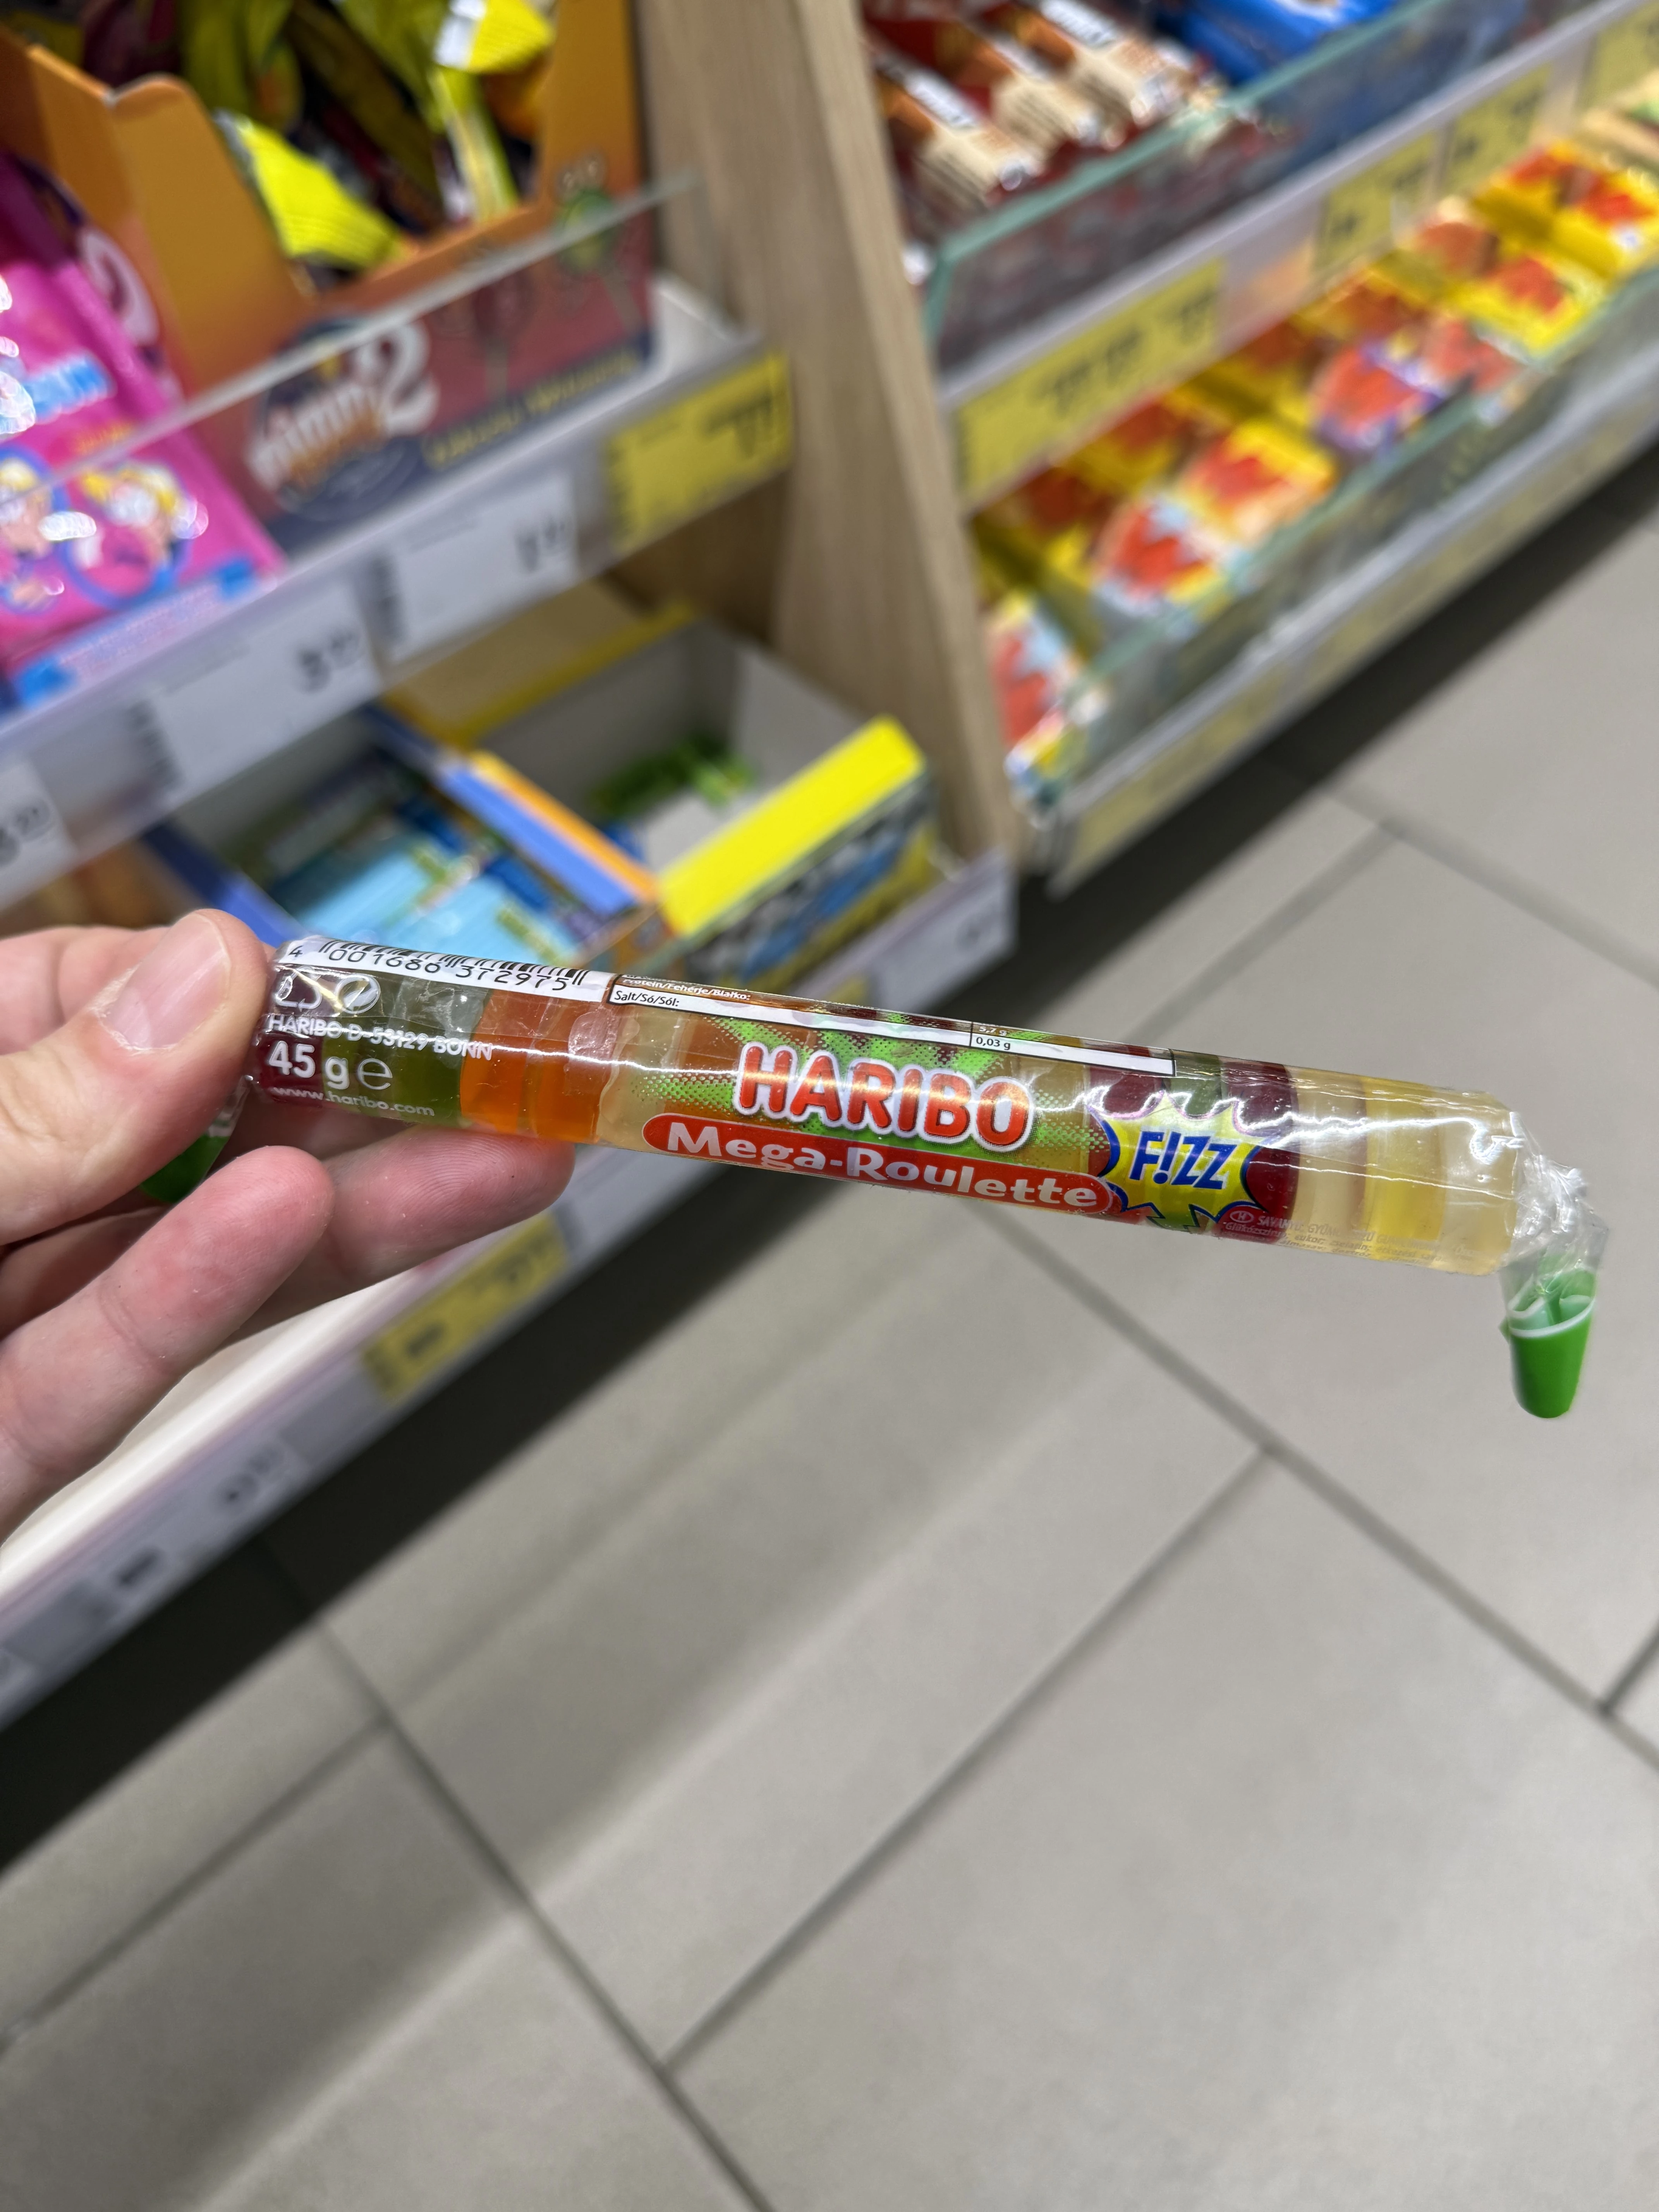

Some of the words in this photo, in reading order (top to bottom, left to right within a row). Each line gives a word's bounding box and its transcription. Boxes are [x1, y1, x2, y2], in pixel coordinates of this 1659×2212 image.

[289, 945, 303, 958] 4
[328, 949, 441, 973] 001686
[456, 965, 569, 991] 372975
[269, 1015, 342, 1039] HARIBO
[348, 1024, 428, 1051] D-53129
[434, 1035, 492, 1060] BONN
[614, 991, 679, 1006] Salt/Só/Sól:
[976, 1037, 1000, 1047] 0,03
[1004, 1042, 1011, 1050] g
[269, 1041, 316, 1078] 45
[325, 1056, 350, 1090] g
[273, 1087, 435, 1116] www.haribo.com
[733, 1042, 1034, 1152] HARIBO
[667, 1121, 1098, 1207] Mega-Roulette
